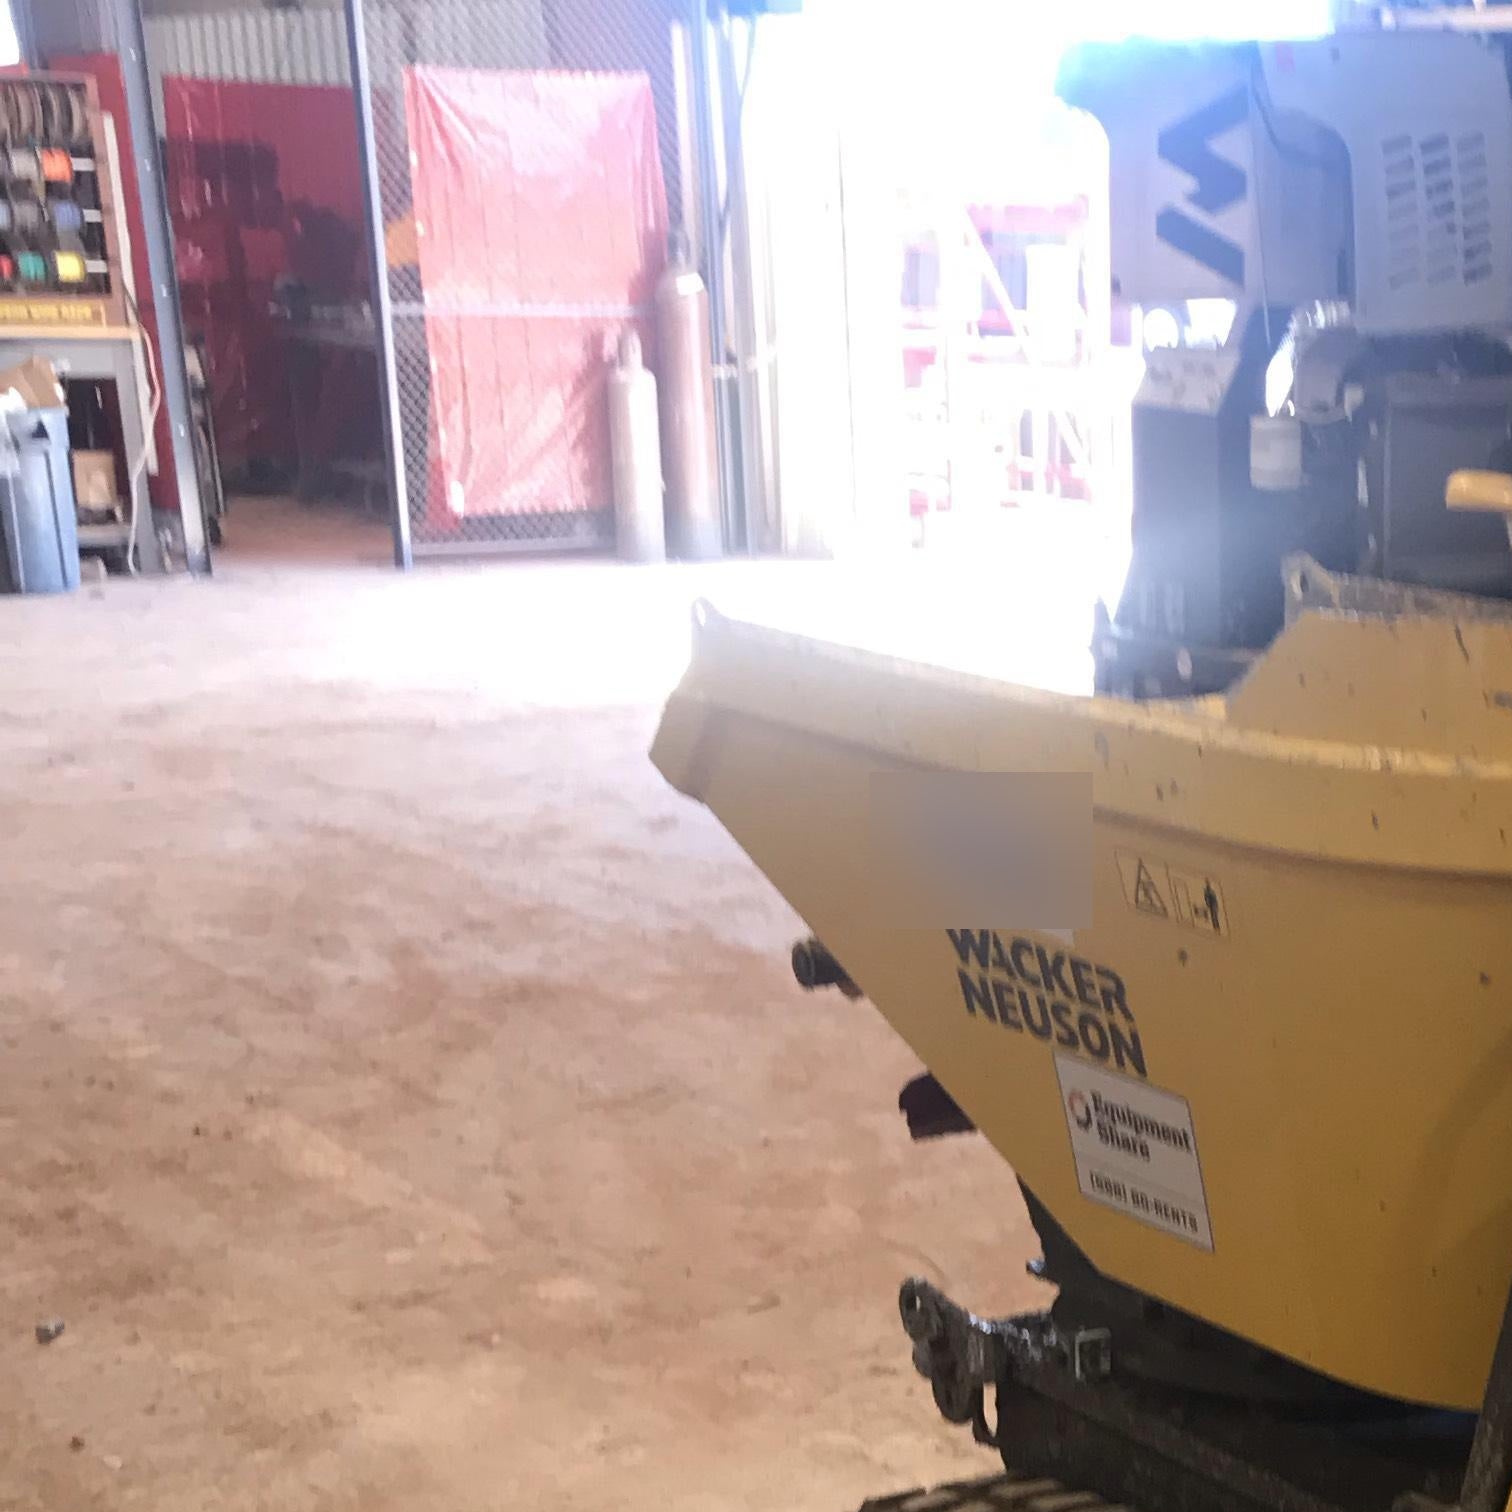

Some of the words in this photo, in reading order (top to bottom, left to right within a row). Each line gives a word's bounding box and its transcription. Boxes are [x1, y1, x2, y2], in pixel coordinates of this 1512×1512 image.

[945, 929, 1135, 1022] WACKER
[957, 967, 1148, 1078] NEUSON
[1091, 1090, 1192, 1153] Equipment
[1097, 1120, 1151, 1162] Share
